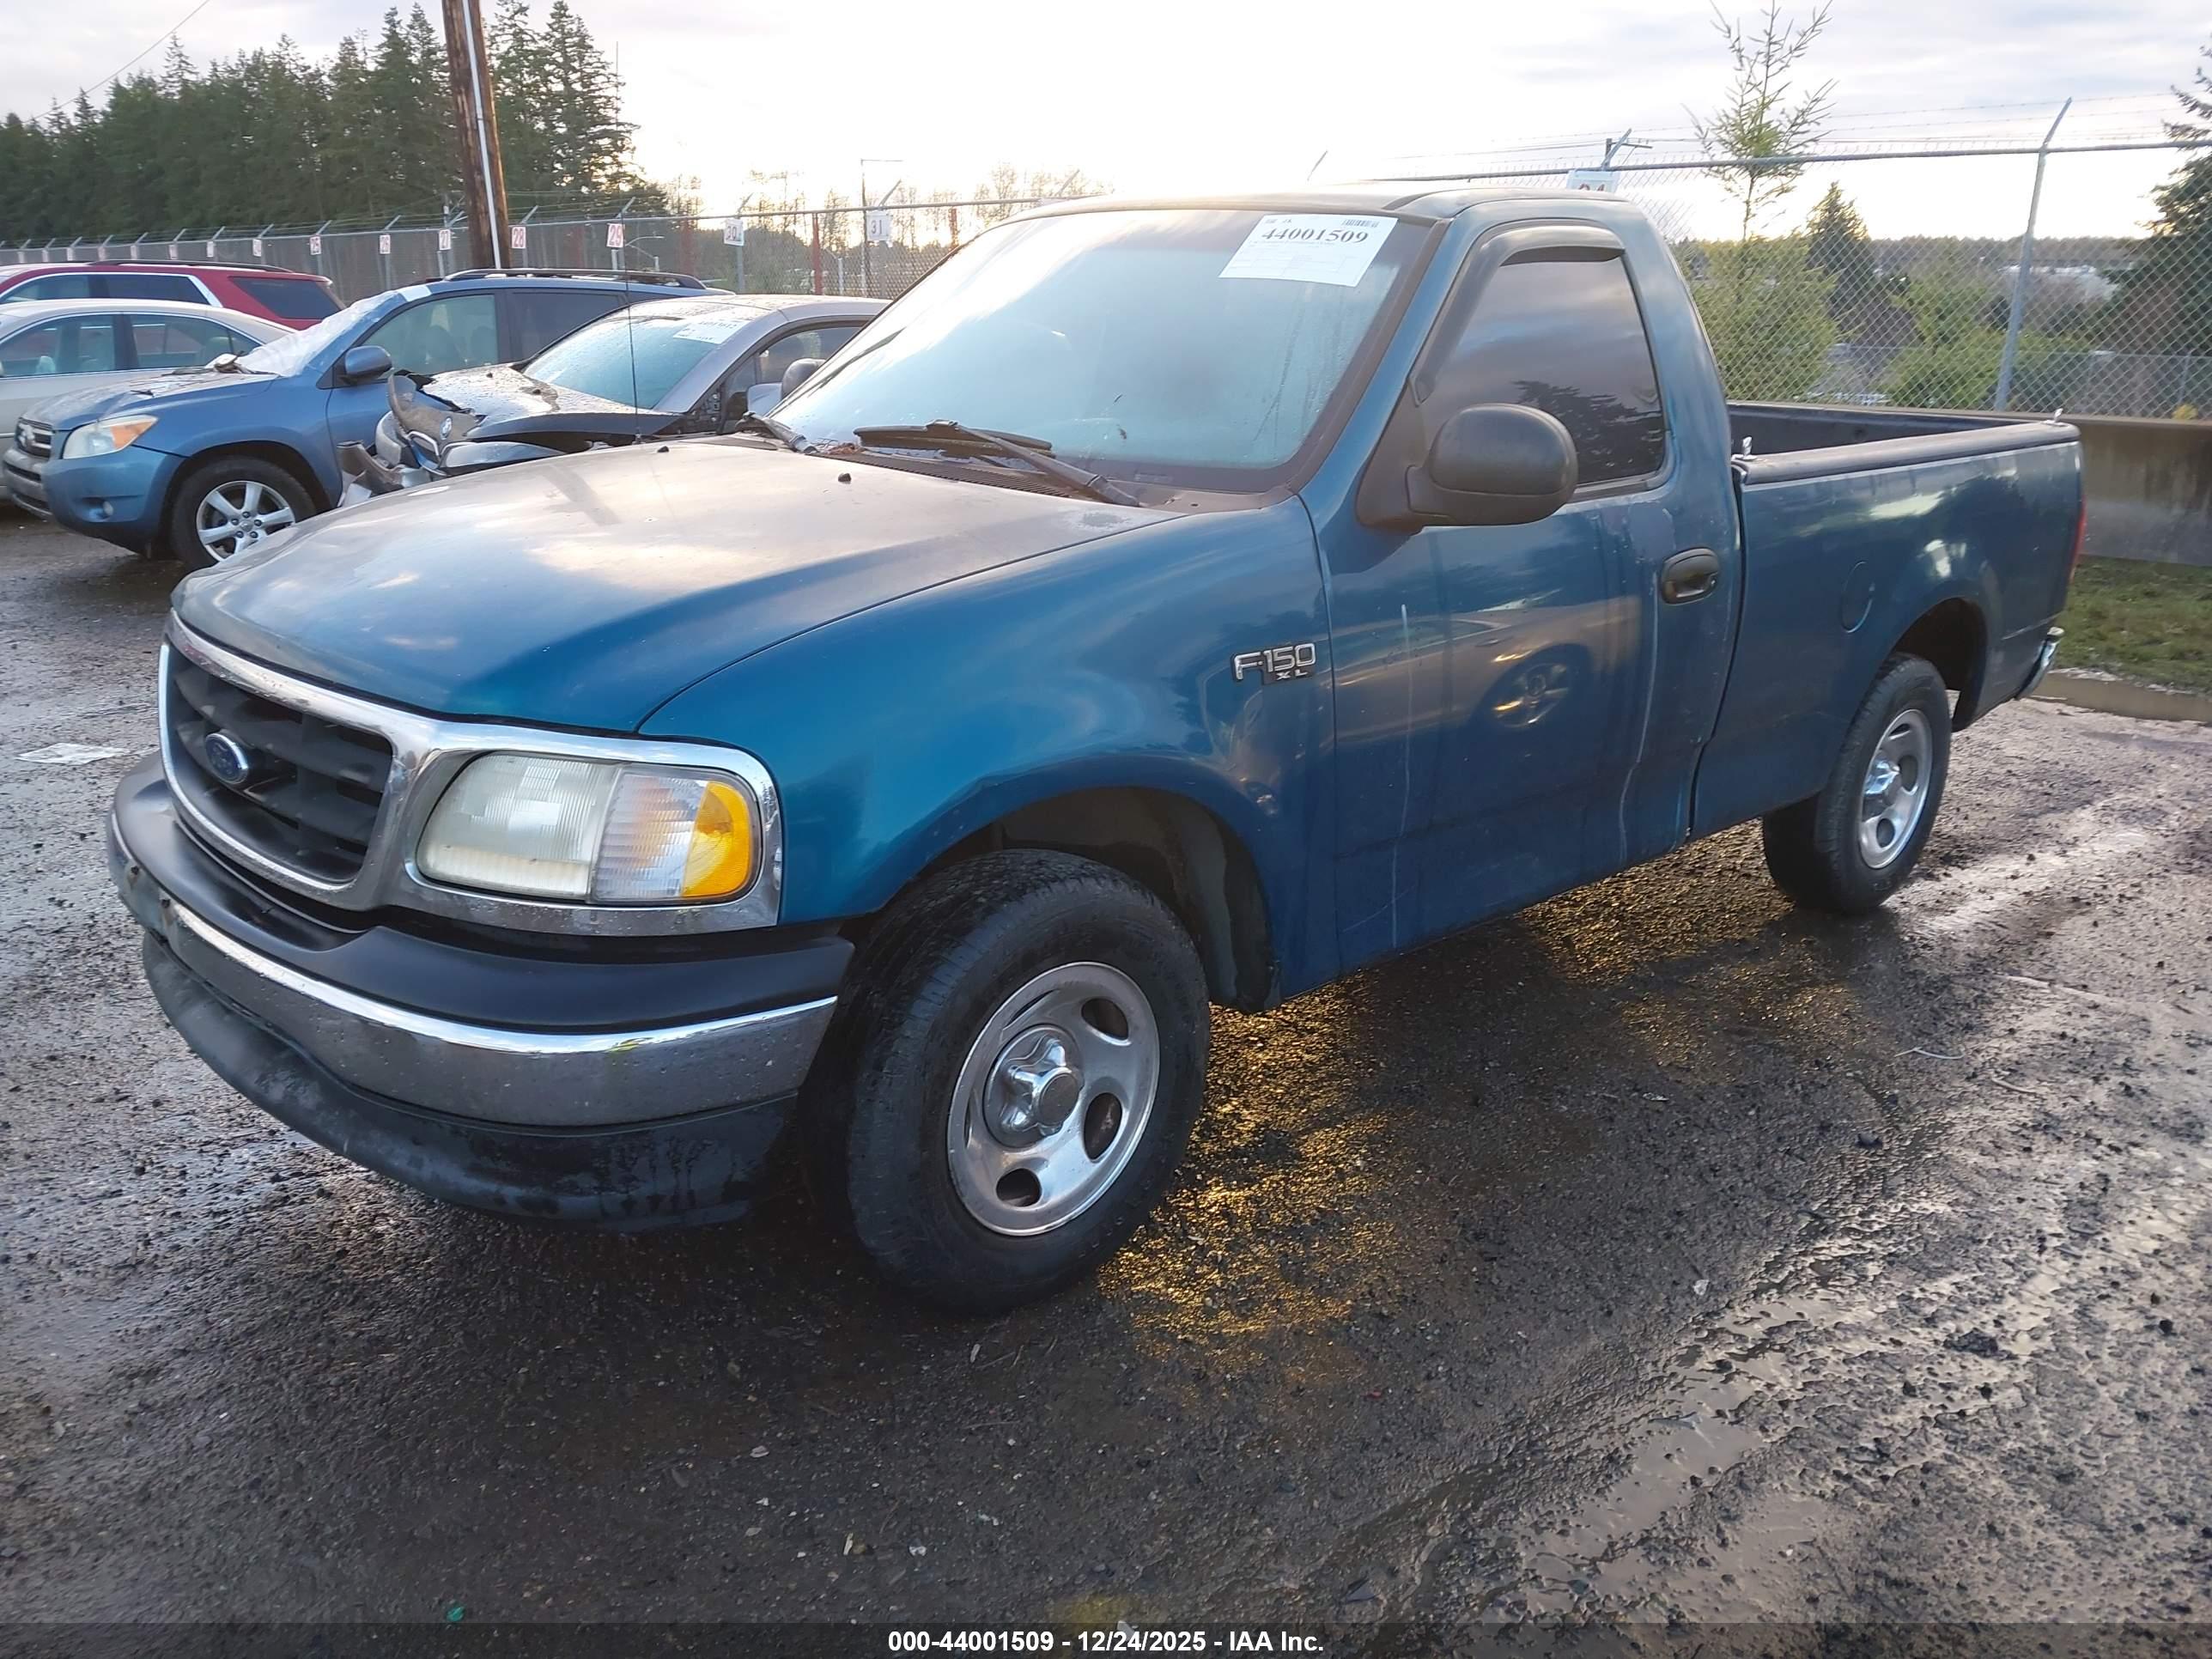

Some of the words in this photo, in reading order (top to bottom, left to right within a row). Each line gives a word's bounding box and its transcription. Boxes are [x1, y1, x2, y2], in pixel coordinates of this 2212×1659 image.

[610, 225, 623, 246] 29
[871, 220, 883, 235] 31
[514, 228, 525, 247] 28
[1261, 228, 1369, 244] 44001509
[1276, 670, 1309, 681] XL
